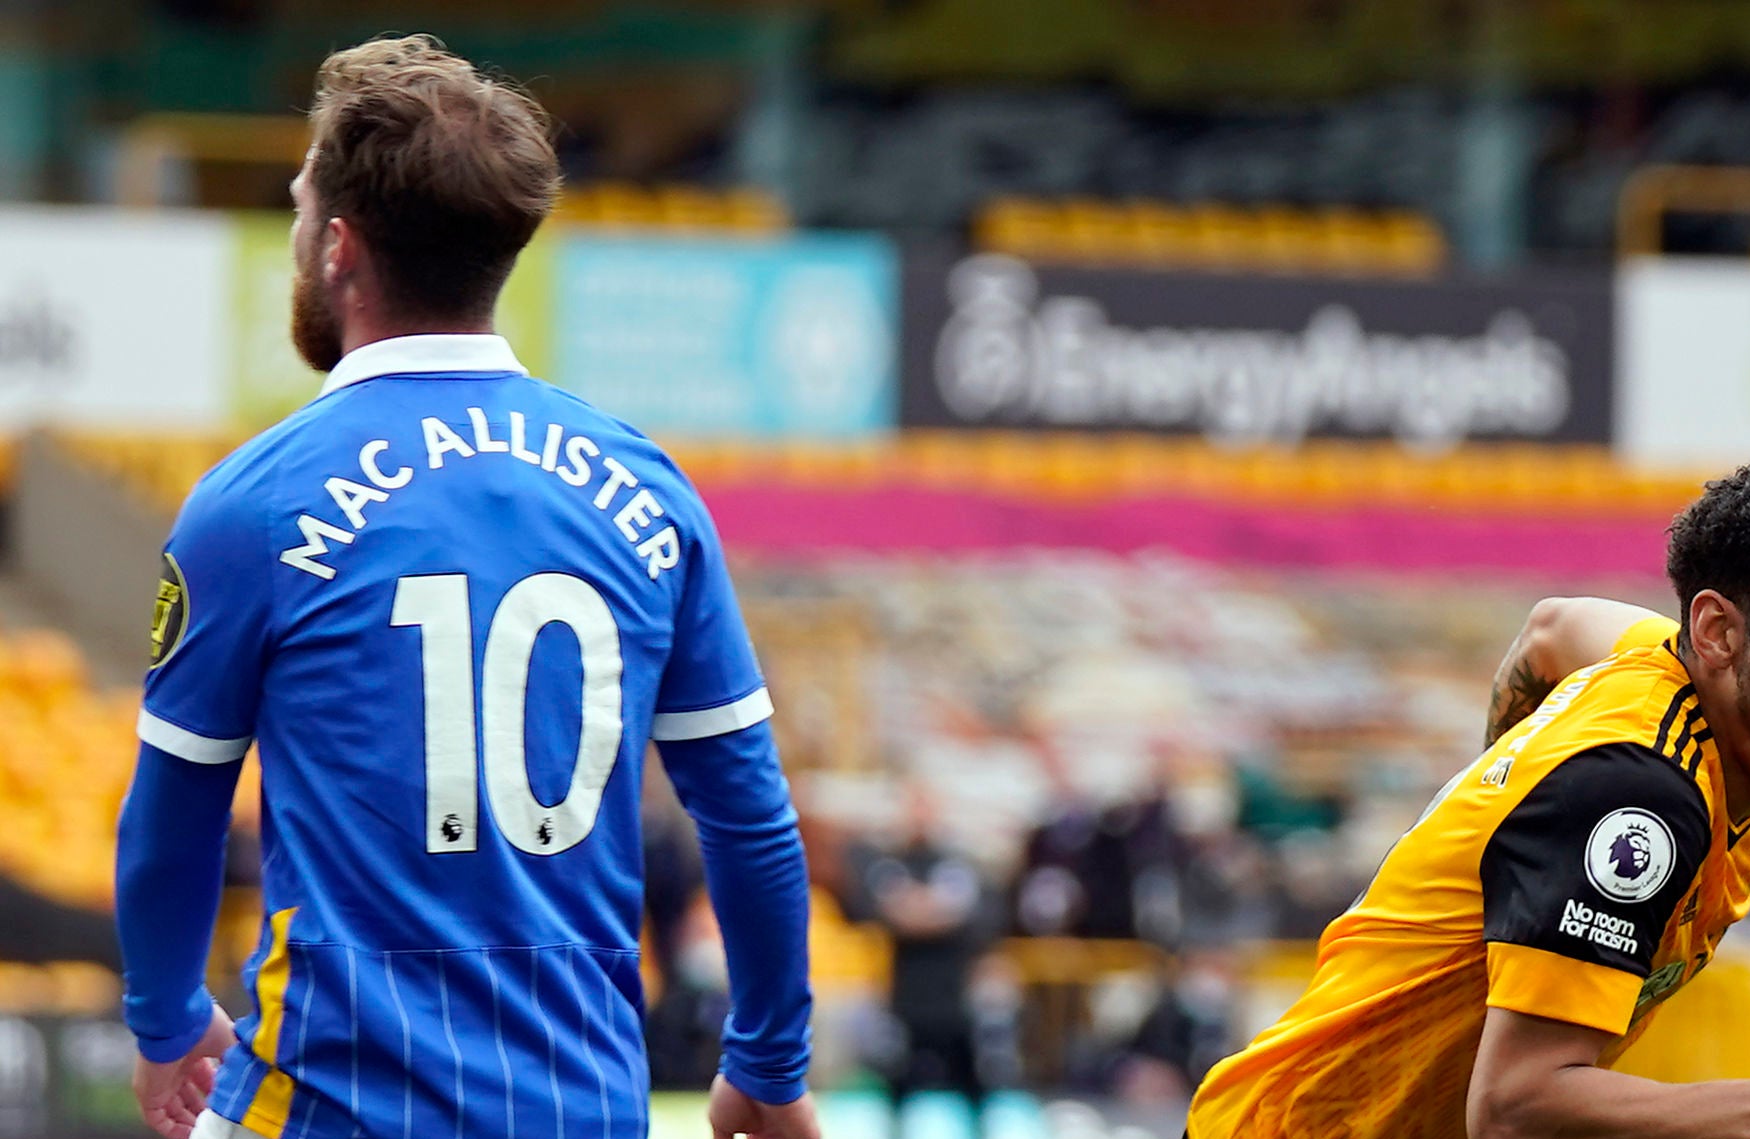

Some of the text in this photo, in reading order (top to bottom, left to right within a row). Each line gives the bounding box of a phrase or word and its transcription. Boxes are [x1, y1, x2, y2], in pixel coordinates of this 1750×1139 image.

[279, 406, 681, 580] MAC ALLISTER
[389, 572, 624, 856] 10
[1613, 882, 1641, 892] Premier
[1563, 898, 1635, 937] No room
[1587, 926, 1638, 955] racism
